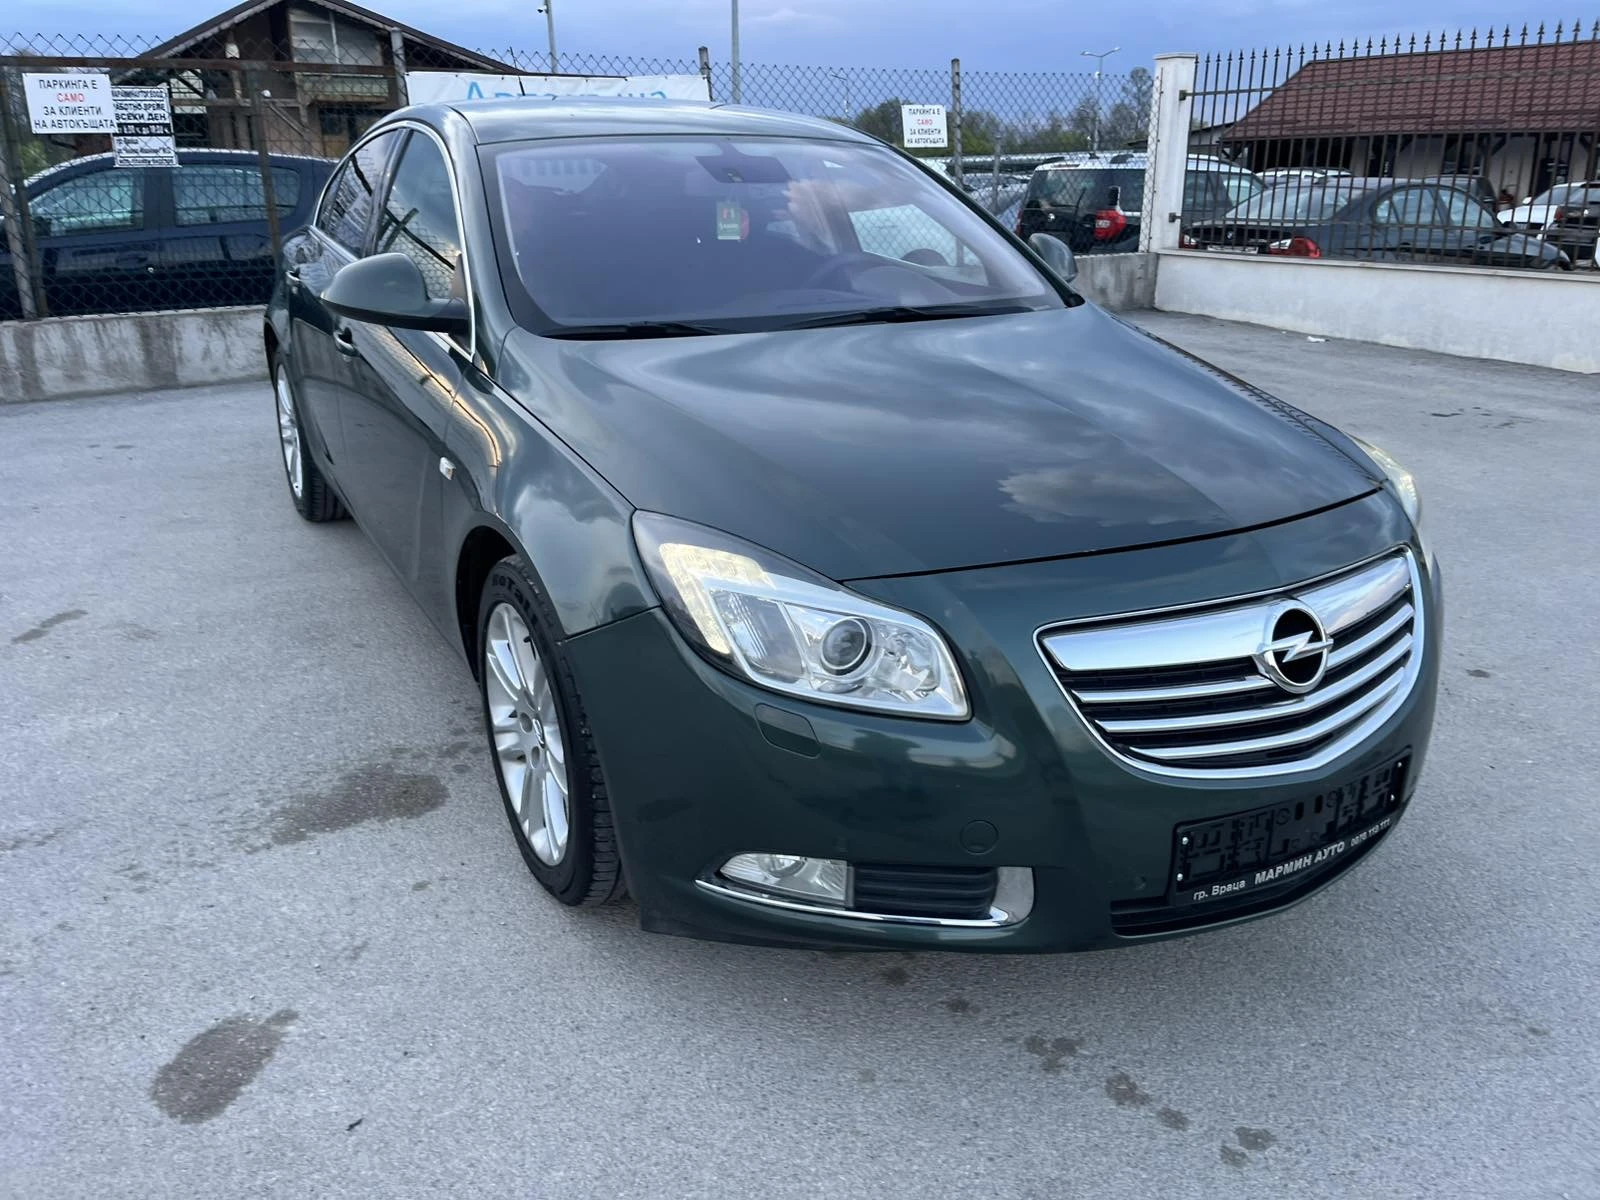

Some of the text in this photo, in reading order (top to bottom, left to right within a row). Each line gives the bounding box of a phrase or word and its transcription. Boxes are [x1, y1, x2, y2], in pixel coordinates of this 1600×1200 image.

[39, 79, 98, 89] ПАРКИНГА Е
[56, 92, 85, 102] САМО
[43, 105, 104, 116] ЗА КЛИЕНТИ
[115, 112, 167, 121] ВСЕКИ ДЕН
[34, 119, 116, 129] НА АВТОКЪЩАТА
[1193, 890, 1209, 901] гр.
[1211, 878, 1247, 896] Враца
[1254, 853, 1313, 885] МАРМИН
[1313, 840, 1346, 864] АУТО
